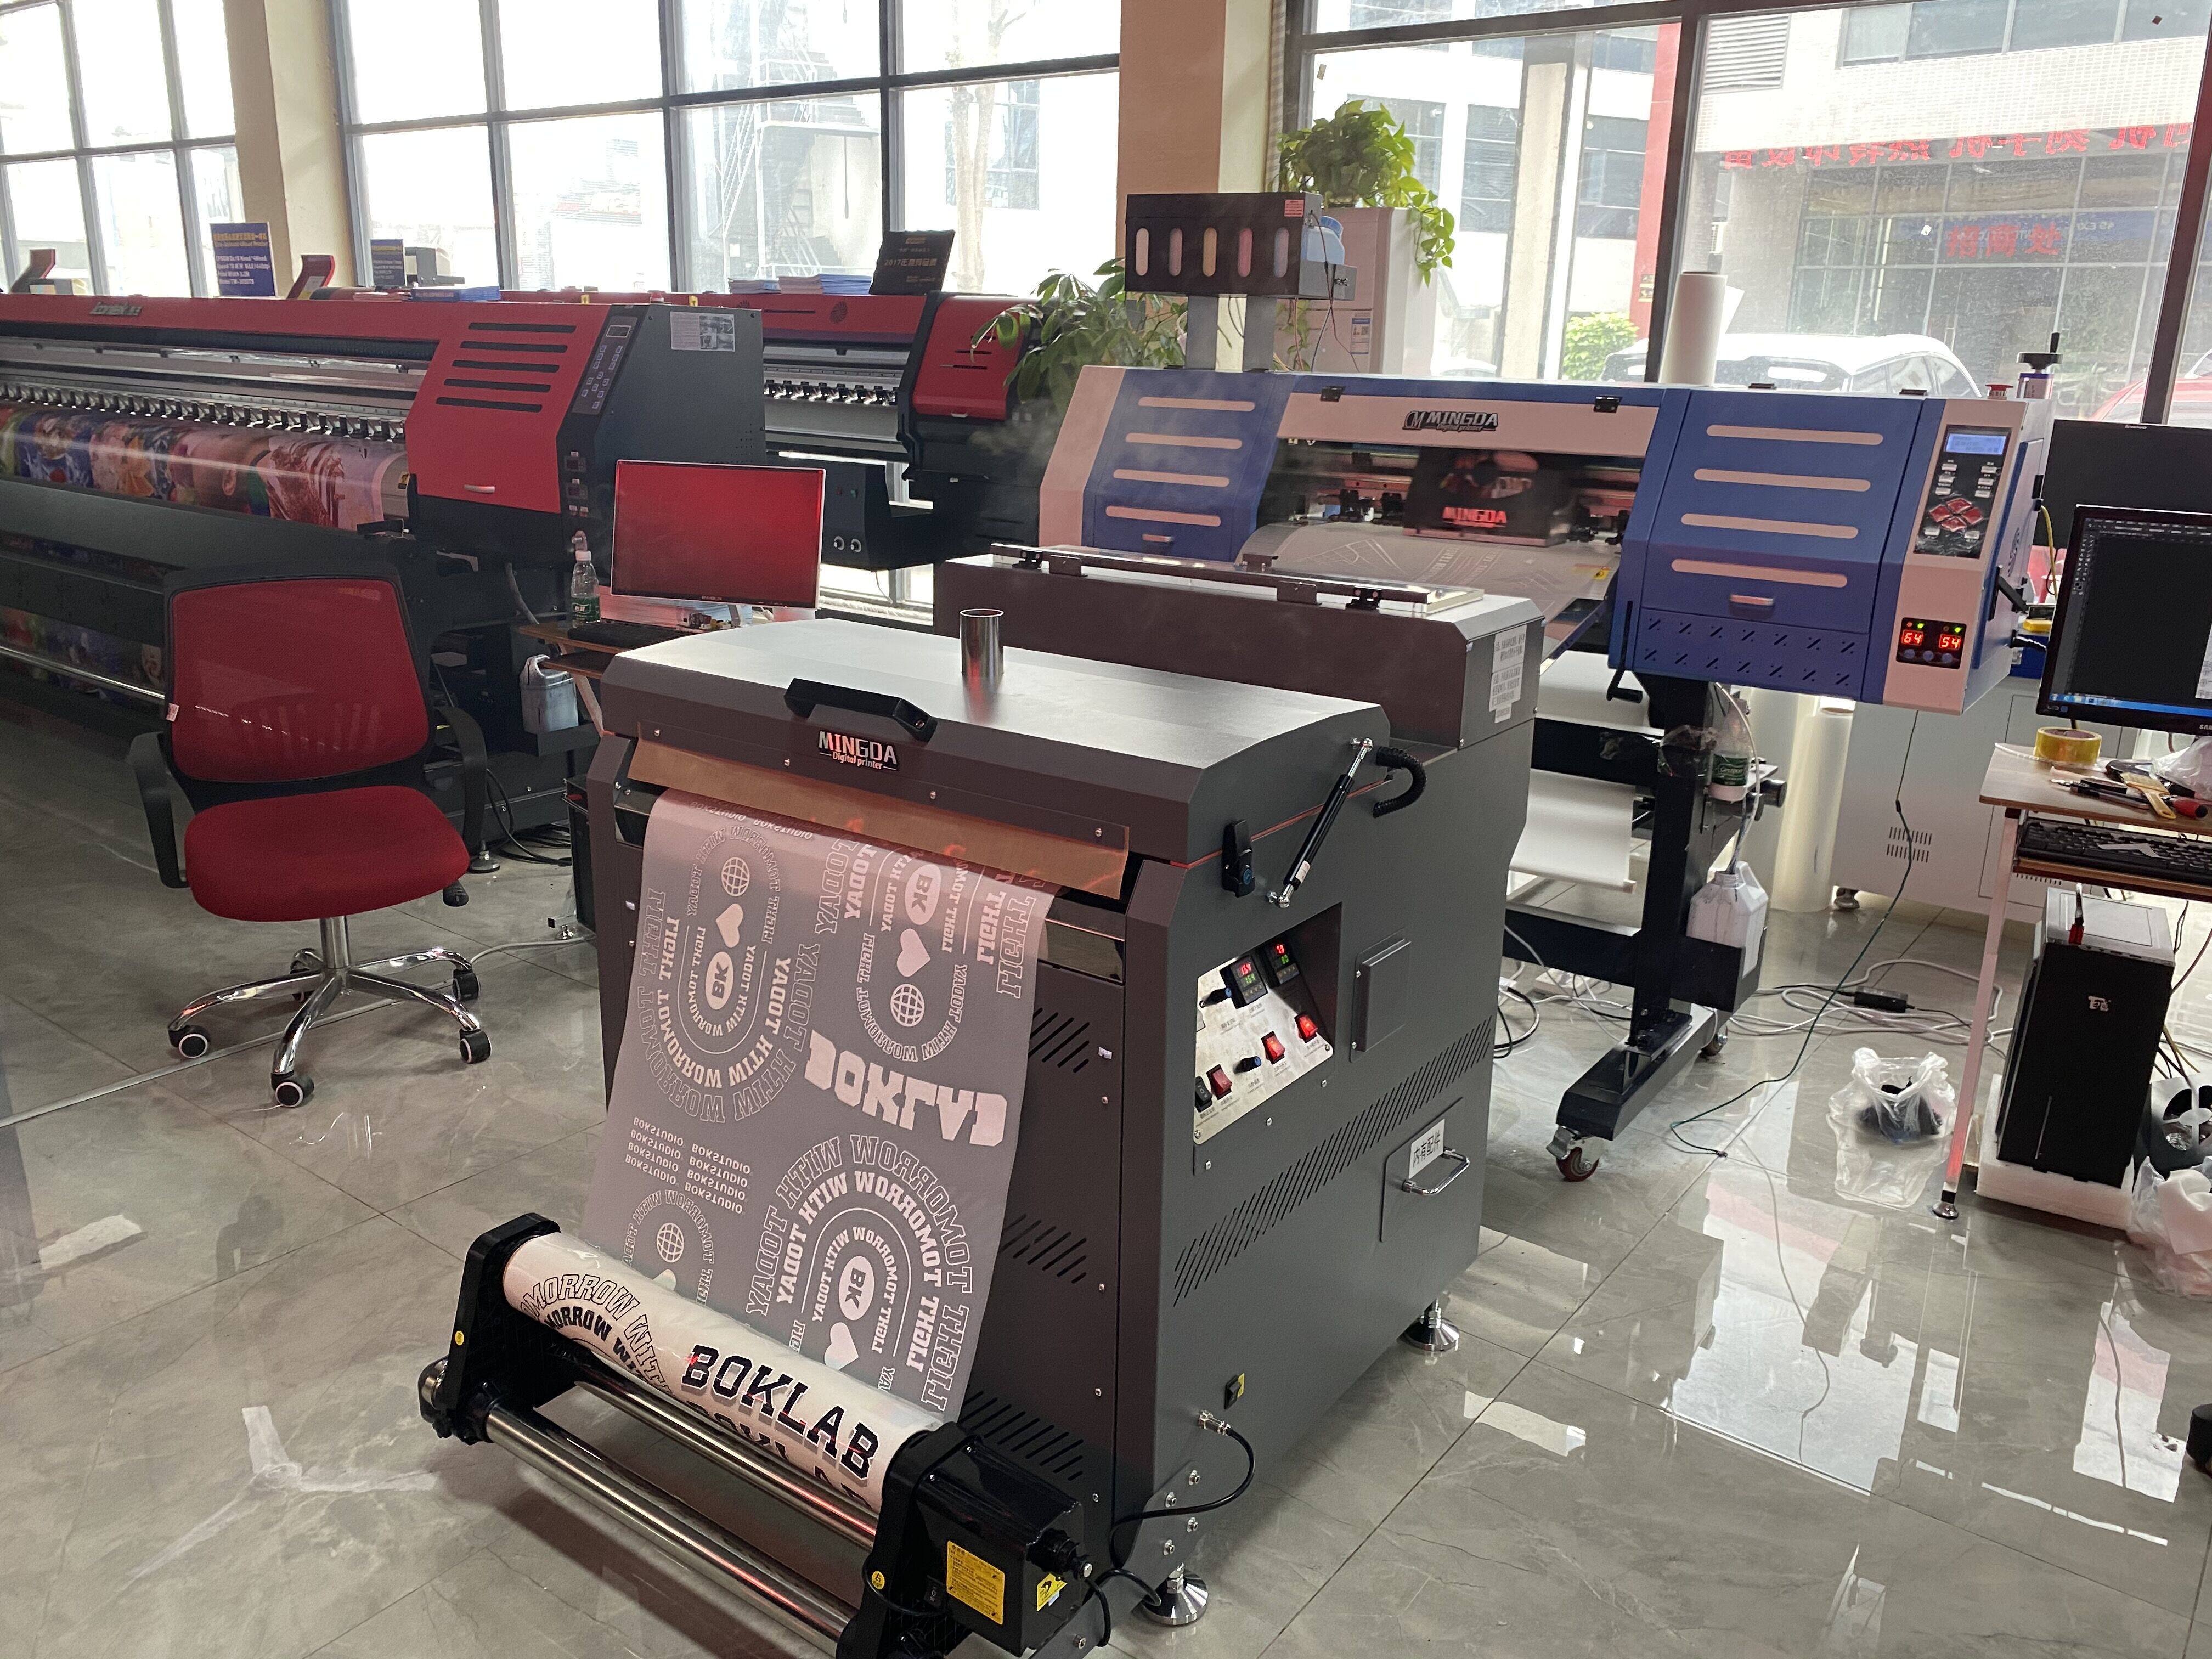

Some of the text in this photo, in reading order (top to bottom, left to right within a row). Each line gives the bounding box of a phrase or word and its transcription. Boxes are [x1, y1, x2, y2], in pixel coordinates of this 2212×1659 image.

[1946, 222, 2063, 259] 招商处
[1426, 411, 1498, 426] MINGDA
[1904, 632, 1922, 644] 64
[1941, 636, 1961, 648] 54
[819, 731, 897, 765] MINGDA
[832, 751, 883, 769] Digital printer
[1413, 1130, 1440, 1167] 内有配件
[680, 1344, 879, 1481] BOKLAB
